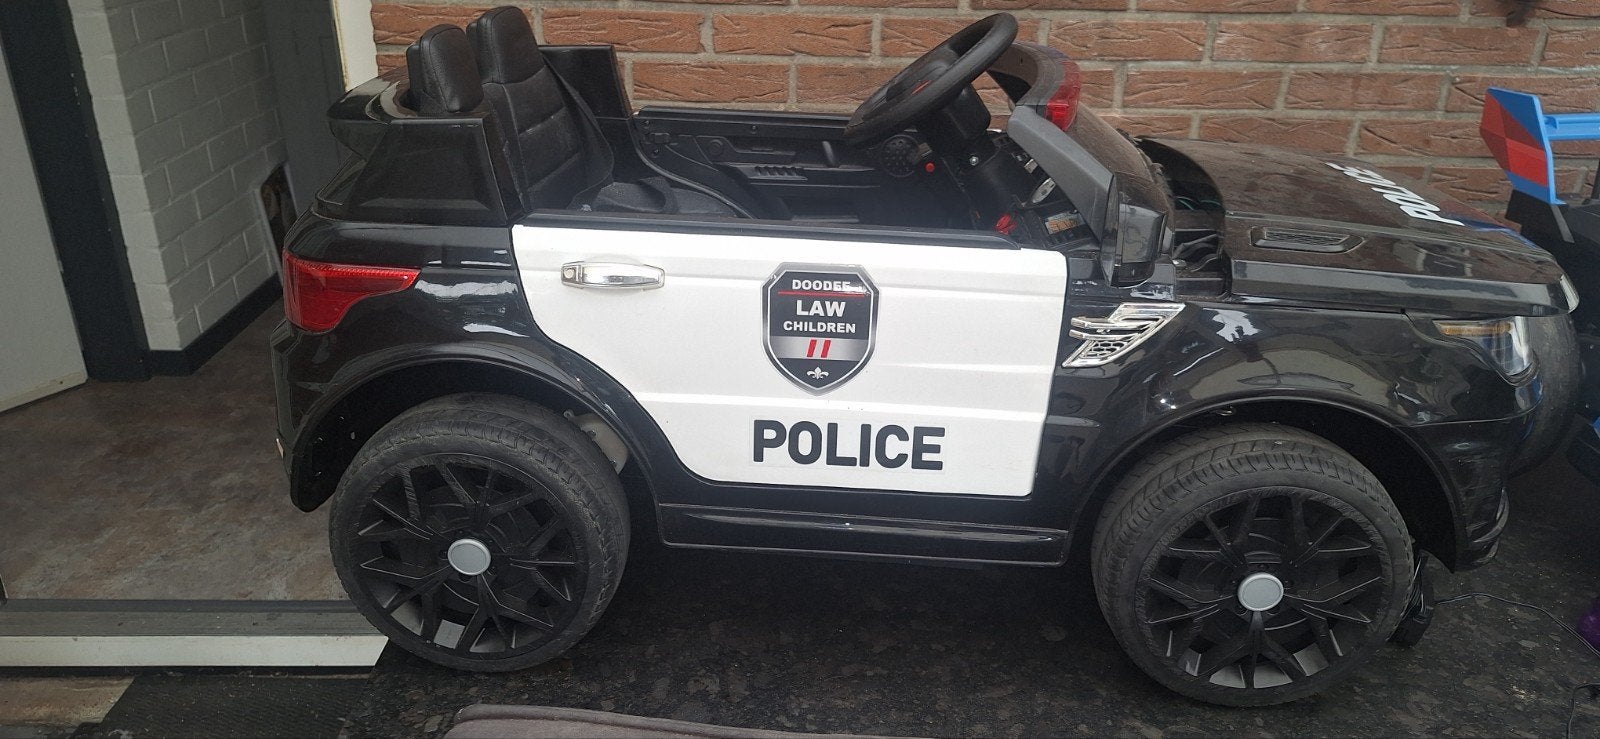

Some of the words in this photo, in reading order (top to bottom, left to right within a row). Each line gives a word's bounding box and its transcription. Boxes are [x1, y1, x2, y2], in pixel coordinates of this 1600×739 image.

[1324, 162, 1466, 227] POLICE
[796, 299, 846, 317] LAW
[783, 320, 856, 334] CHILDREN
[753, 419, 946, 471] POLICE
